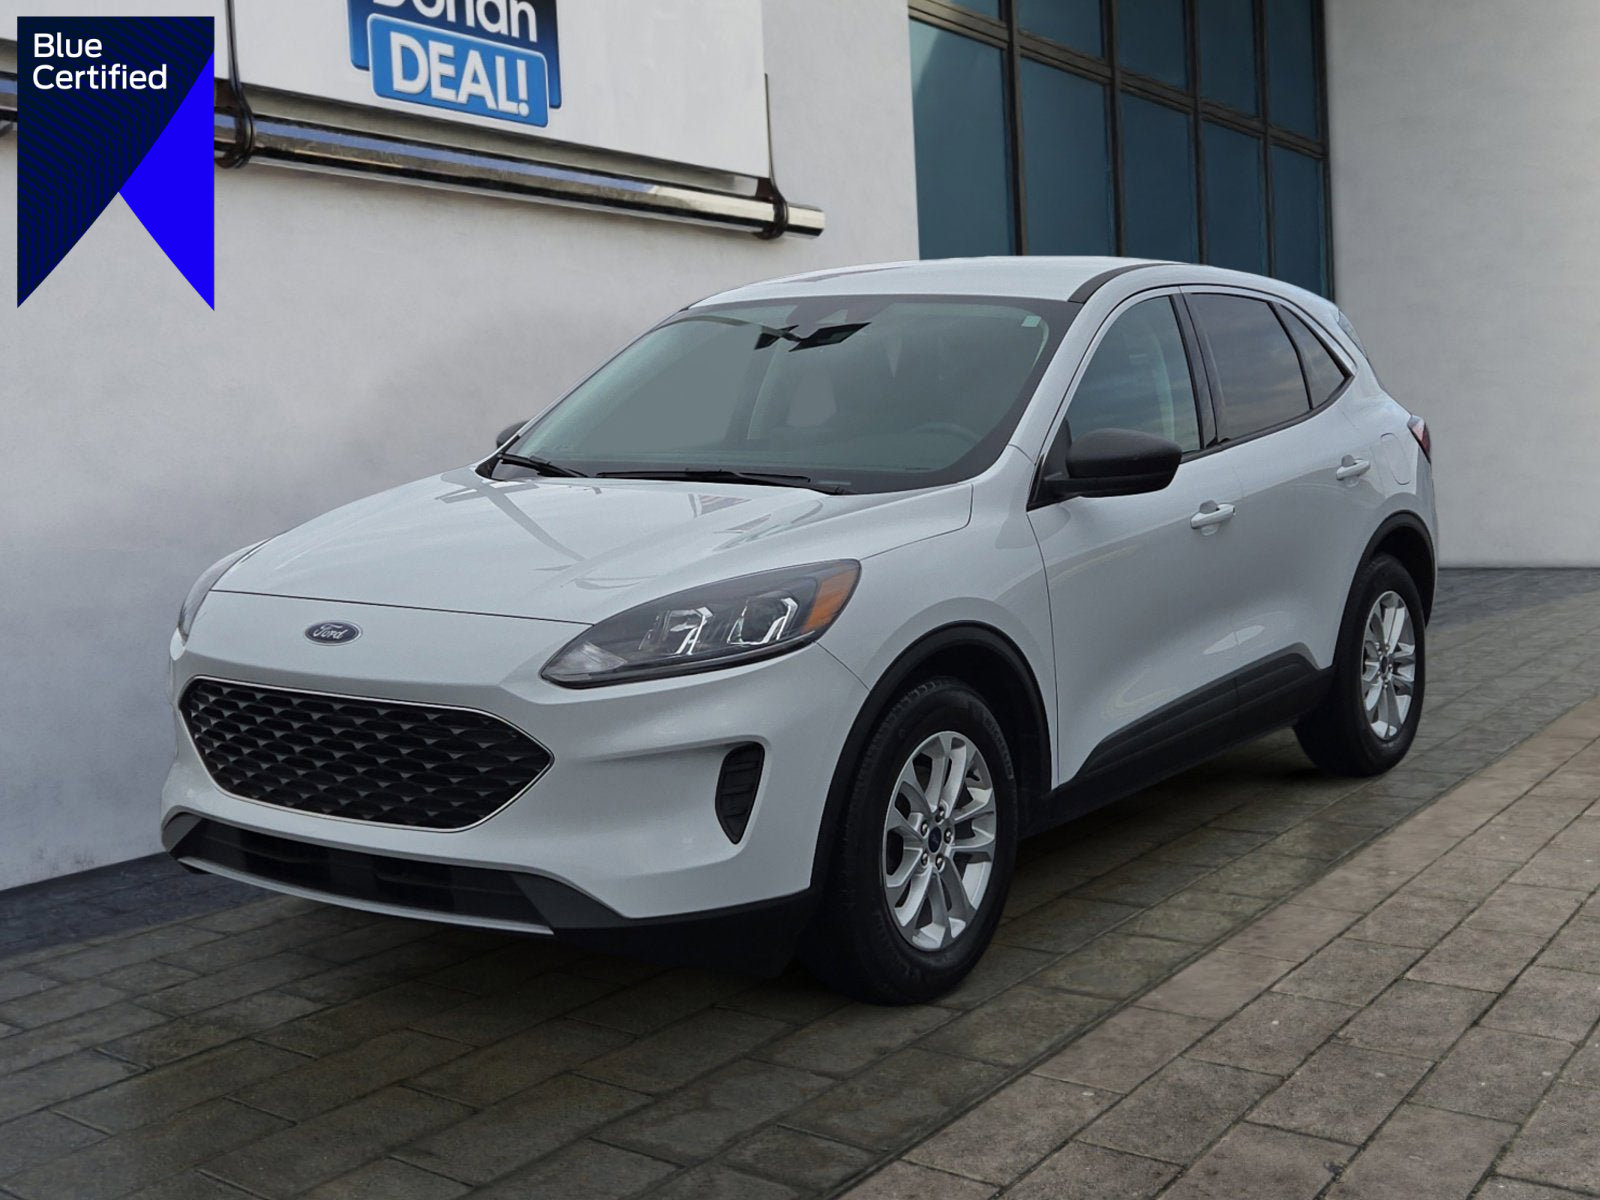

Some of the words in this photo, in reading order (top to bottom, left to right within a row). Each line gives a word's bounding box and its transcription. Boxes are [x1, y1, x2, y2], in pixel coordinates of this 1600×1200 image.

[373, 0, 538, 43] orian
[390, 31, 530, 118] DEAL!
[313, 623, 349, 640] Ford
